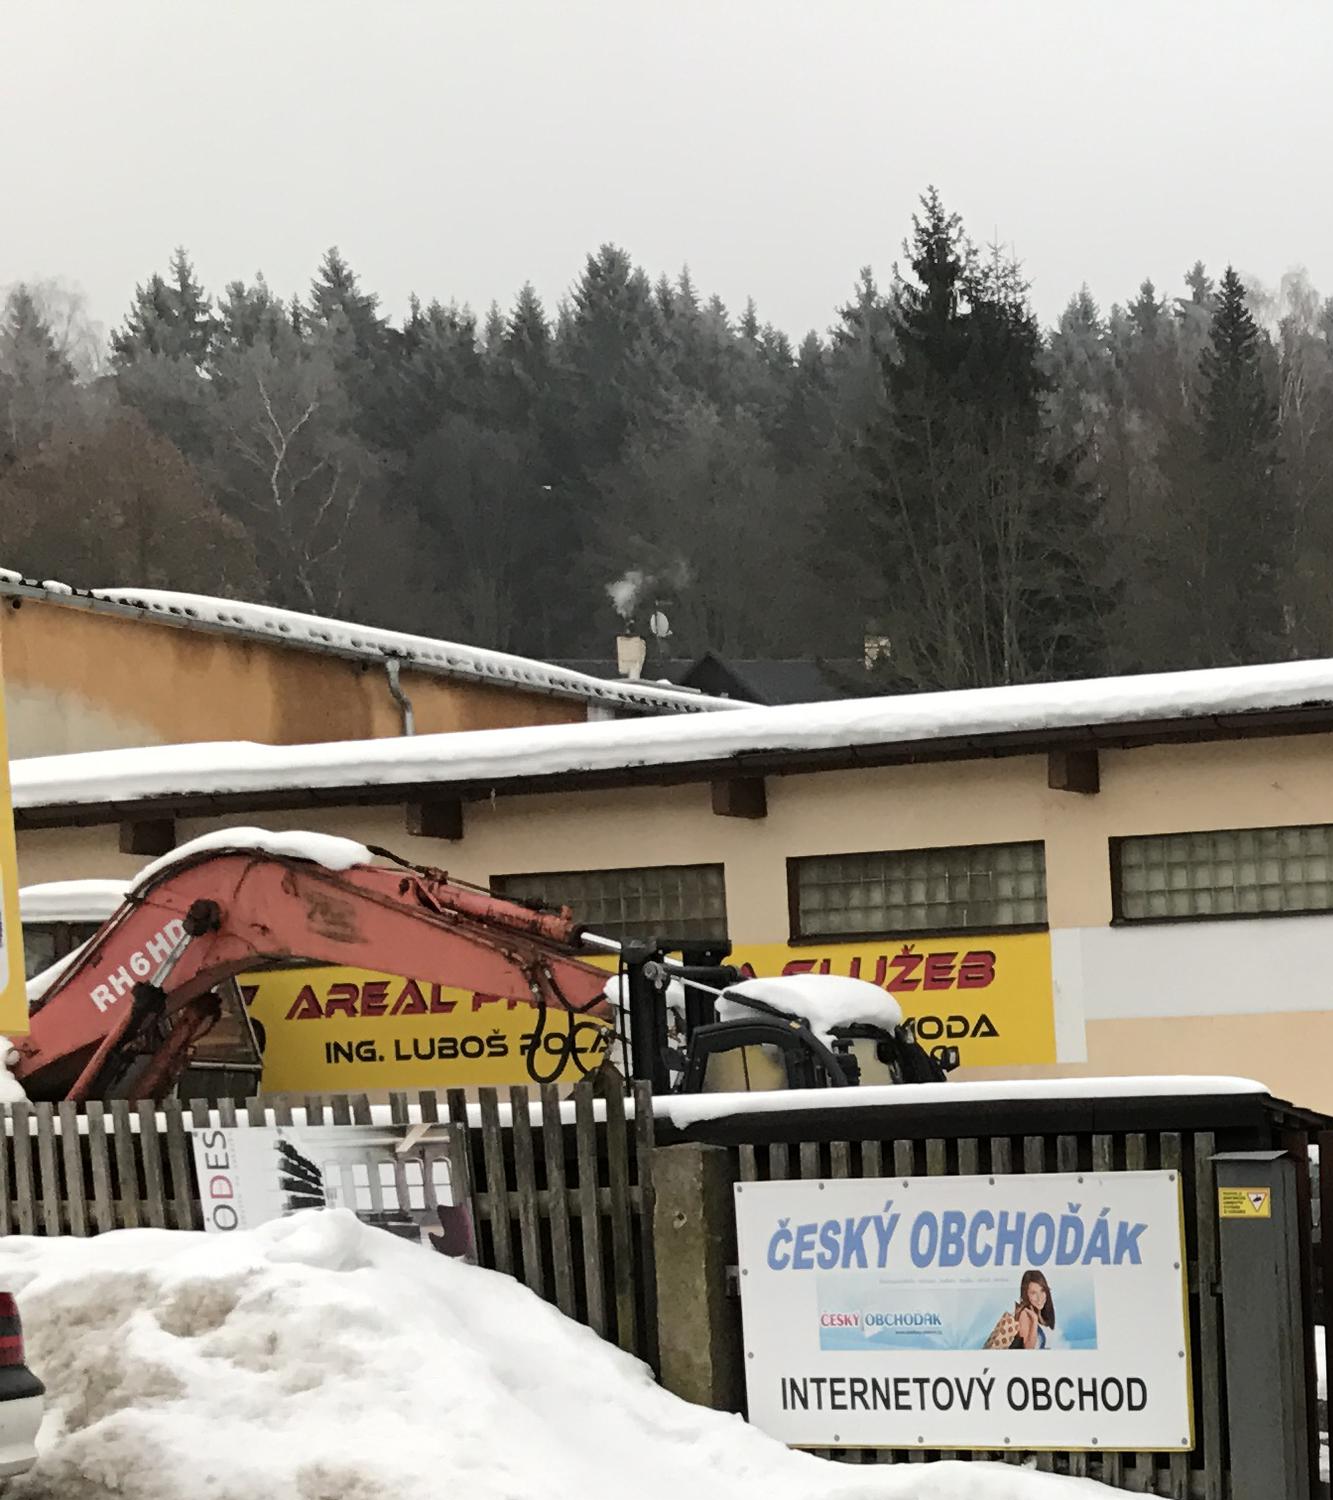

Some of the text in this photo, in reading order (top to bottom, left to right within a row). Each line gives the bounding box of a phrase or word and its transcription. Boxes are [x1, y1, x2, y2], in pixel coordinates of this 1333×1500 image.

[325, 1040, 385, 1065] ING.
[394, 1028, 509, 1062] LUBOŠ
[766, 1199, 1149, 1271] ČESKÝ OBCHOĎÁK
[781, 1367, 1148, 1412] INTERNETOVÝ OBCHOD
